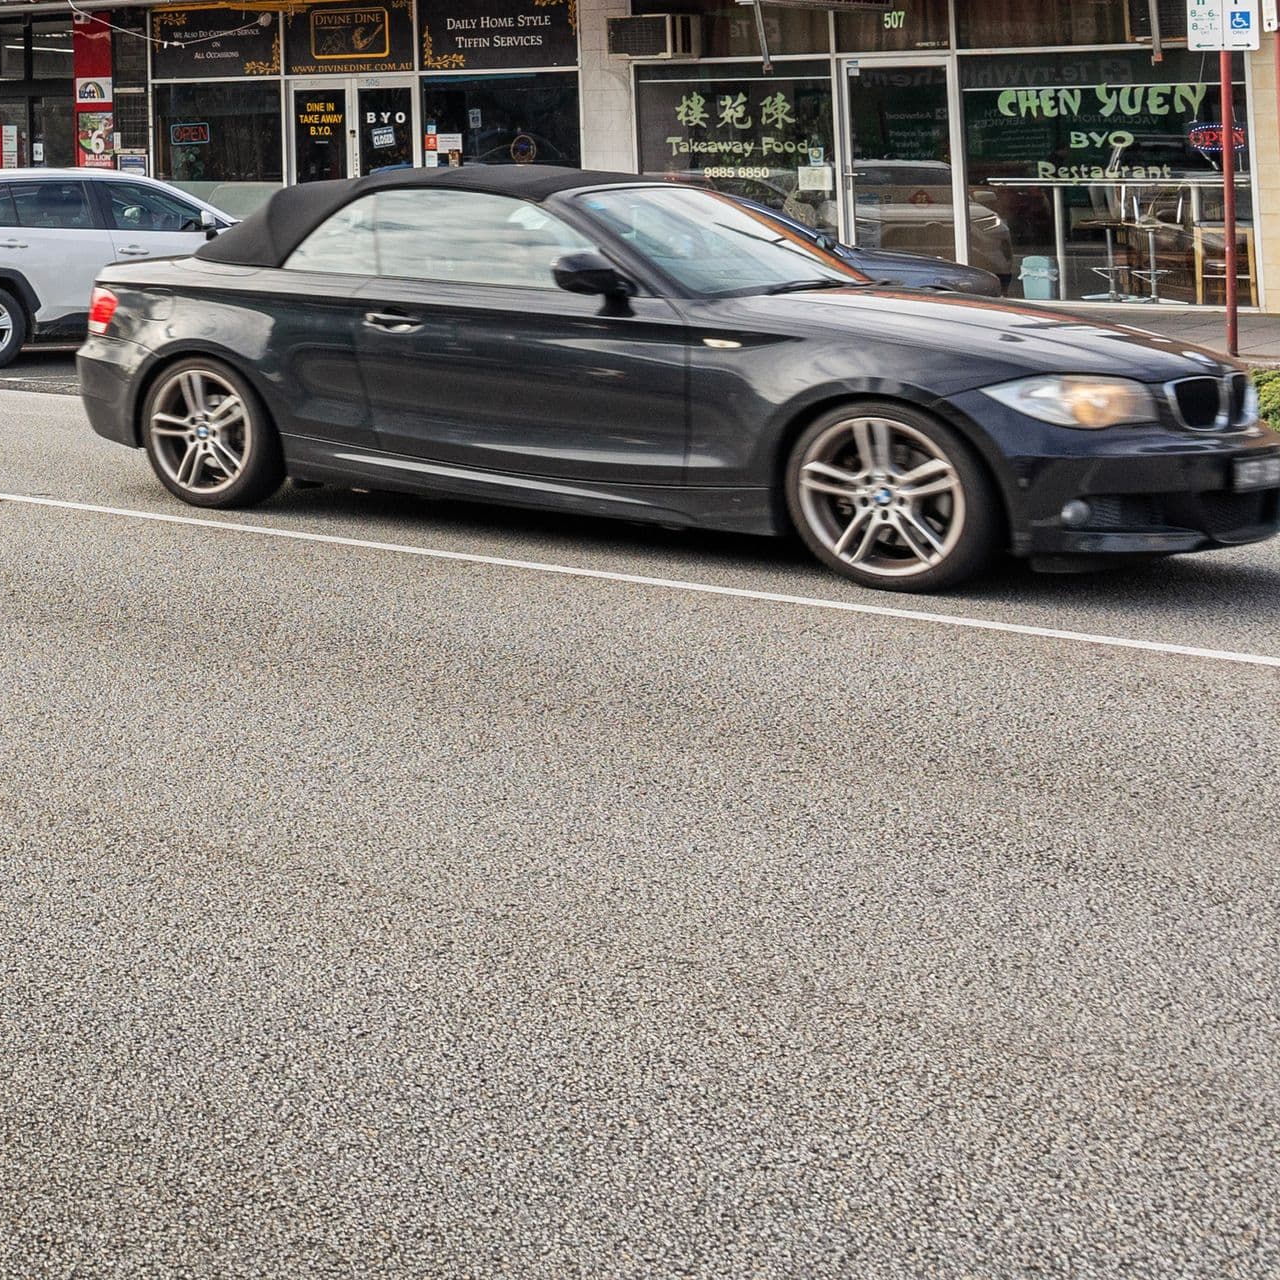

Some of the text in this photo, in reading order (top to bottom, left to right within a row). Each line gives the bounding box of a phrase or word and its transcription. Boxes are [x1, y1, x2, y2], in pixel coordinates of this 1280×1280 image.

[315, 12, 382, 26] DIVINE DINE
[446, 14, 551, 30] DAILY HOME STYLE
[883, 11, 905, 29] 507
[455, 35, 543, 49] TIFFIN SERVICES
[291, 62, 413, 73] WWW.DIVINEDINE.COM.AU
[306, 102, 335, 112] DINE IN
[997, 81, 1208, 118] CHEN YUEN
[299, 114, 343, 124] TAKE AWAY
[173, 125, 208, 142] OPEN
[1069, 130, 1135, 149] BYO
[1190, 129, 1245, 145] OPN
[665, 136, 809, 157] Takeaway Food
[703, 166, 770, 178] 9885 6850
[1037, 161, 1172, 183] Restaurant
